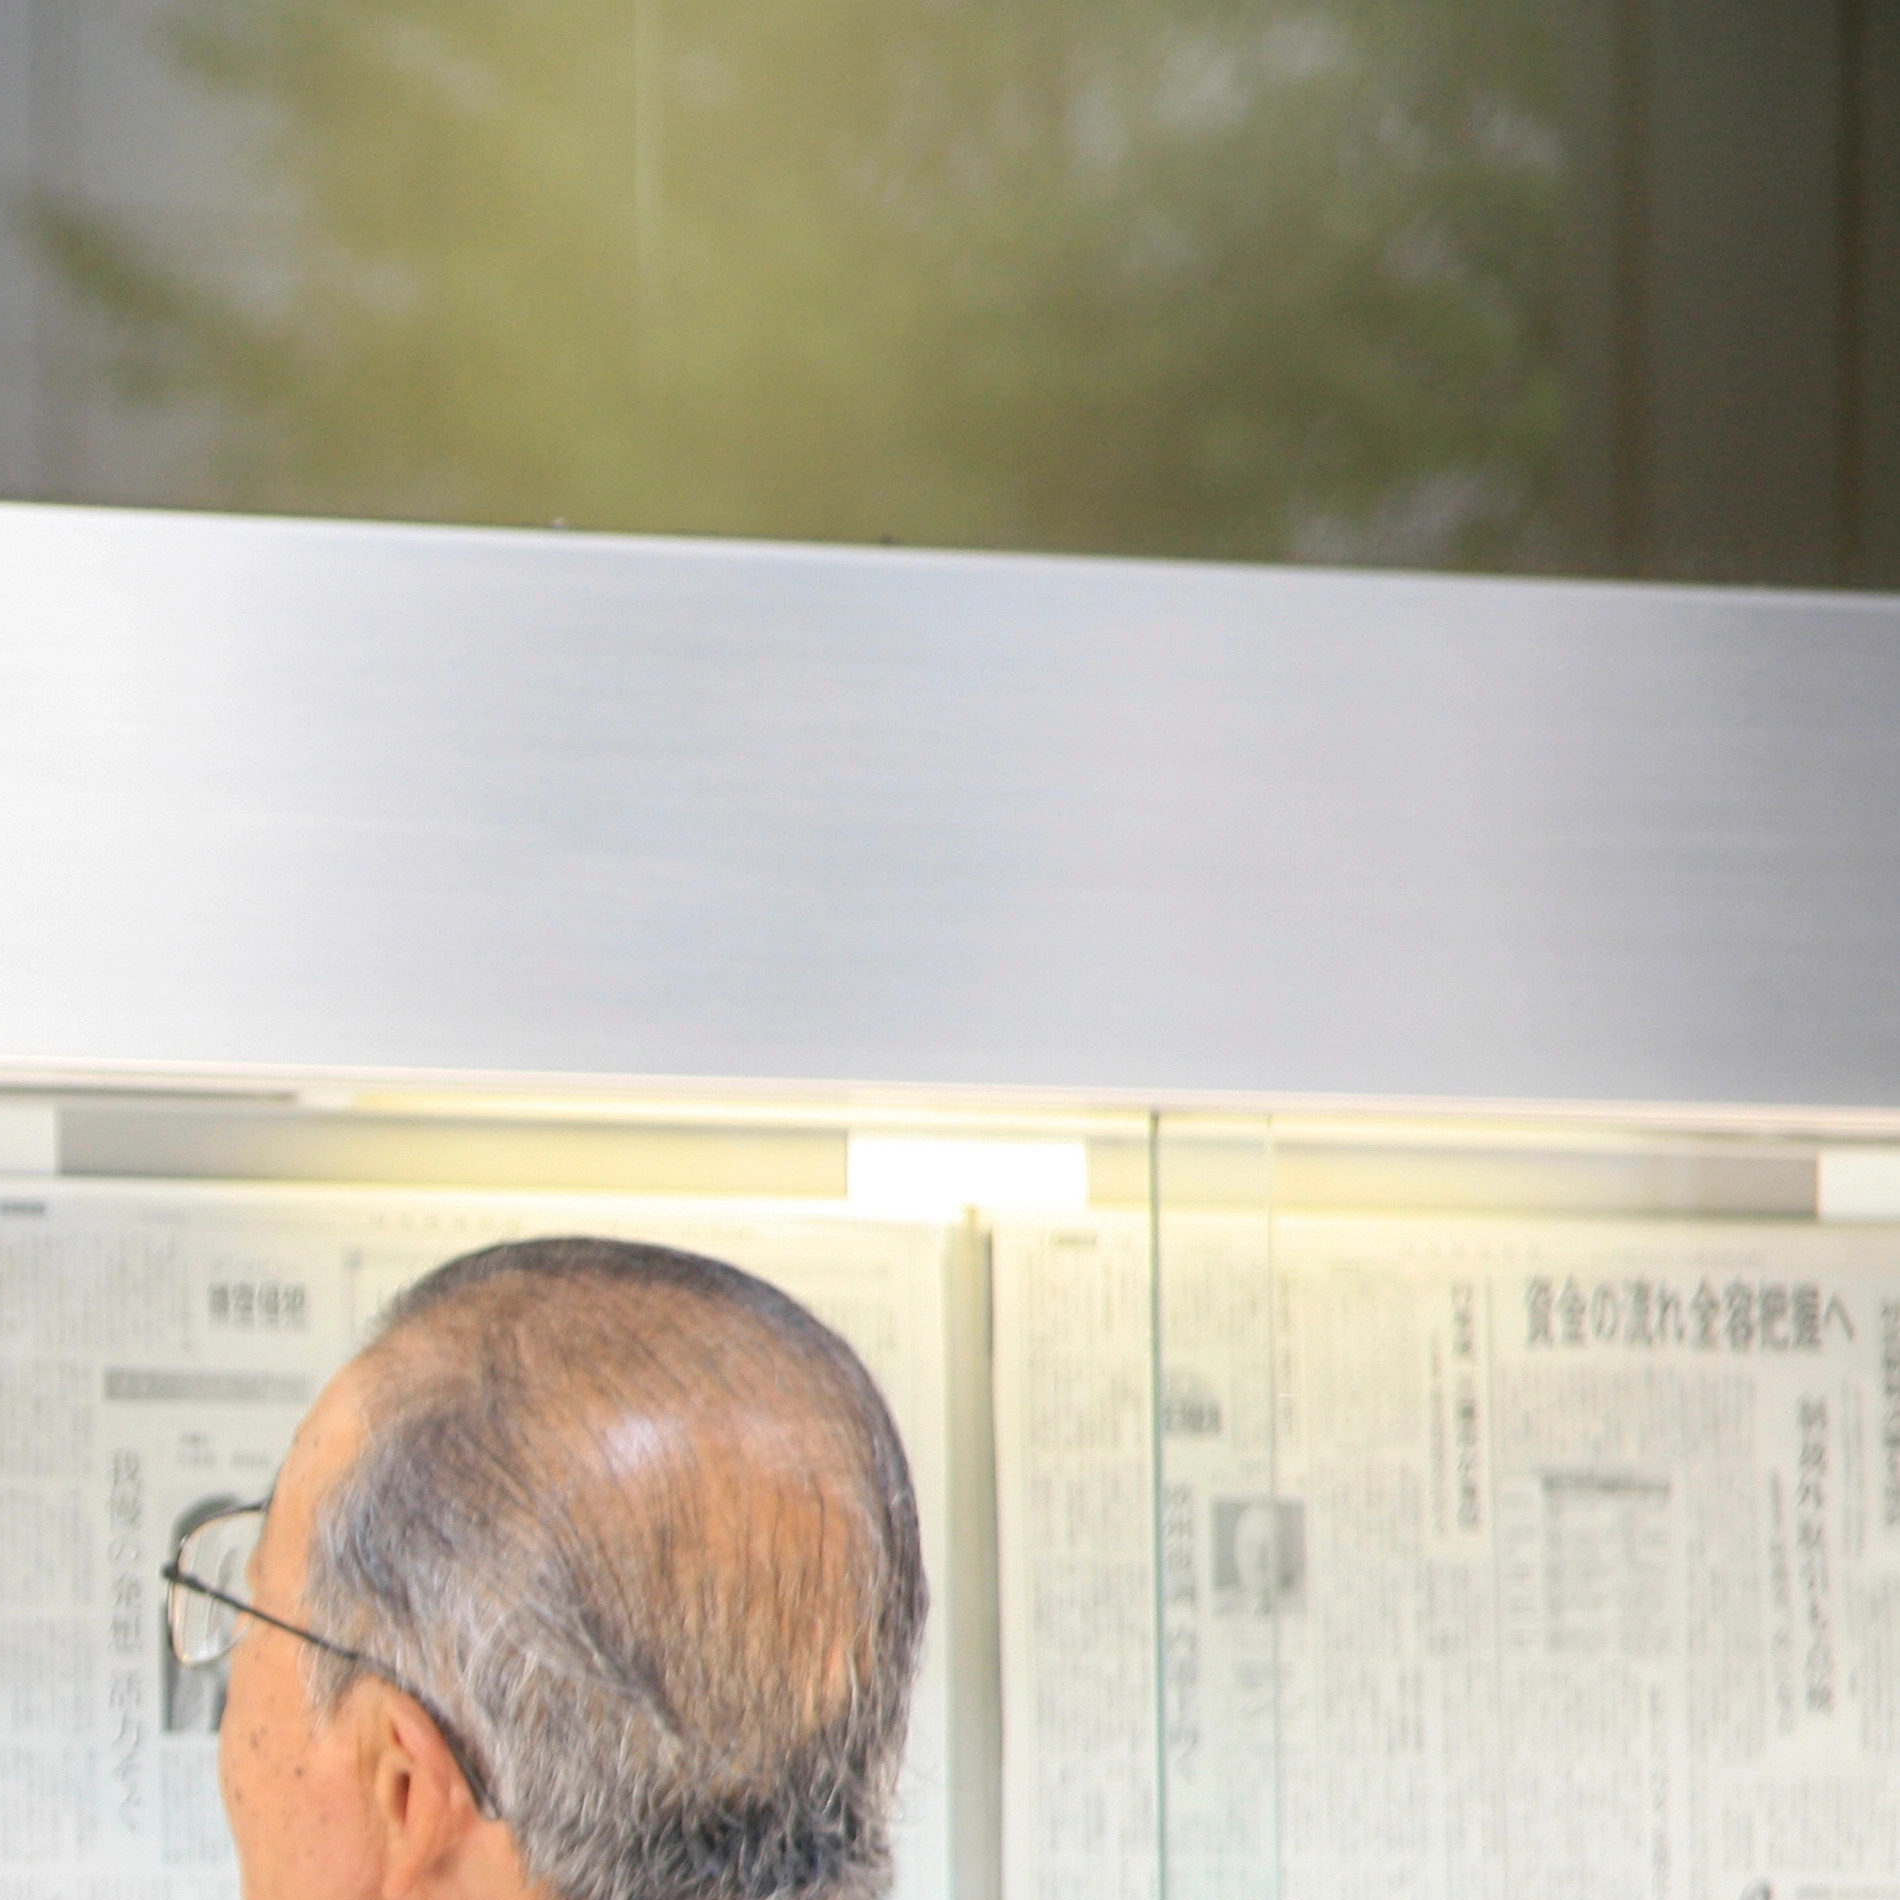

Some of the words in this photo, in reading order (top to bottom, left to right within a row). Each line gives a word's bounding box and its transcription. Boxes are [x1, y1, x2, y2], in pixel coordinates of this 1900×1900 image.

[1526, 1274, 1857, 1352] 資金の流れ全容把握へ
